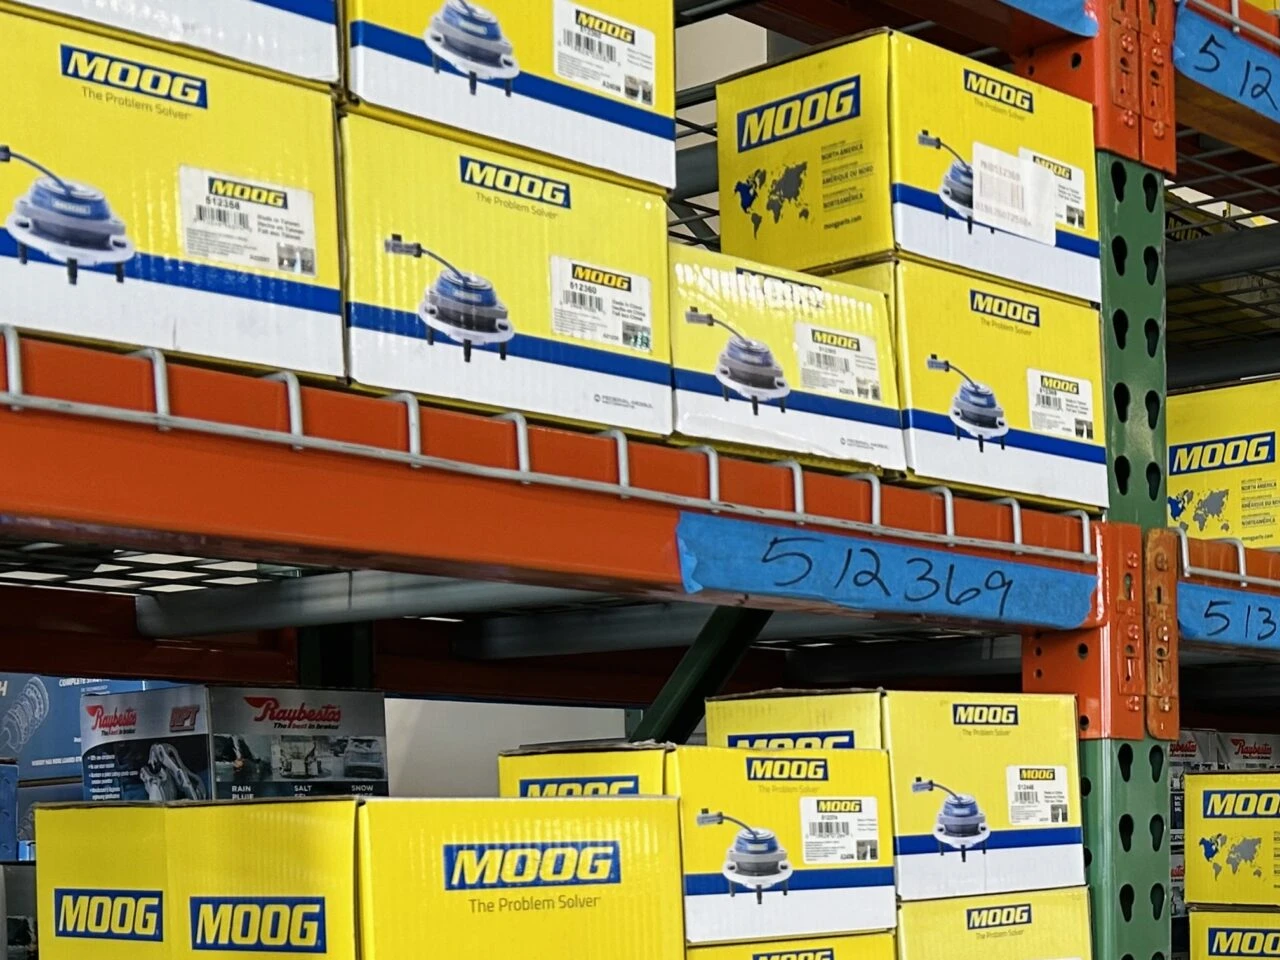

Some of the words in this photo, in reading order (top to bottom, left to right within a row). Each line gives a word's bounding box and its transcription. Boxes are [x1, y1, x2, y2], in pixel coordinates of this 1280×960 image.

[578, 12, 634, 43] MOOG
[67, 52, 203, 105] MOOG
[967, 72, 1031, 111] MOOG
[82, 87, 103, 101] The
[106, 91, 152, 112] Problem
[155, 104, 189, 120] Solver
[742, 82, 855, 147] MOOG
[212, 179, 286, 207] MOOG
[465, 161, 568, 205] MOOG
[476, 192, 491, 205] The
[494, 196, 528, 212] Problem
[531, 206, 557, 219] Solver
[575, 266, 628, 288] MOOG
[973, 292, 1038, 325] MOOG
[814, 331, 858, 349] MOOG
[1042, 377, 1078, 393] MOOG
[1173, 438, 1270, 470] MOOG
[761, 537, 1012, 615] 512369
[244, 697, 341, 726] Raybestos
[956, 706, 1017, 723] MOOG
[750, 759, 825, 779] MOOG
[1021, 769, 1054, 779] MOOG
[819, 801, 861, 812] MOOG
[451, 846, 613, 886] MOOG
[59, 896, 159, 936] MOOG
[469, 899, 495, 912] The
[499, 898, 555, 911] Problem
[559, 896, 597, 908] Solver
[970, 906, 1031, 928] MOOG
[197, 904, 320, 947] MOOG
